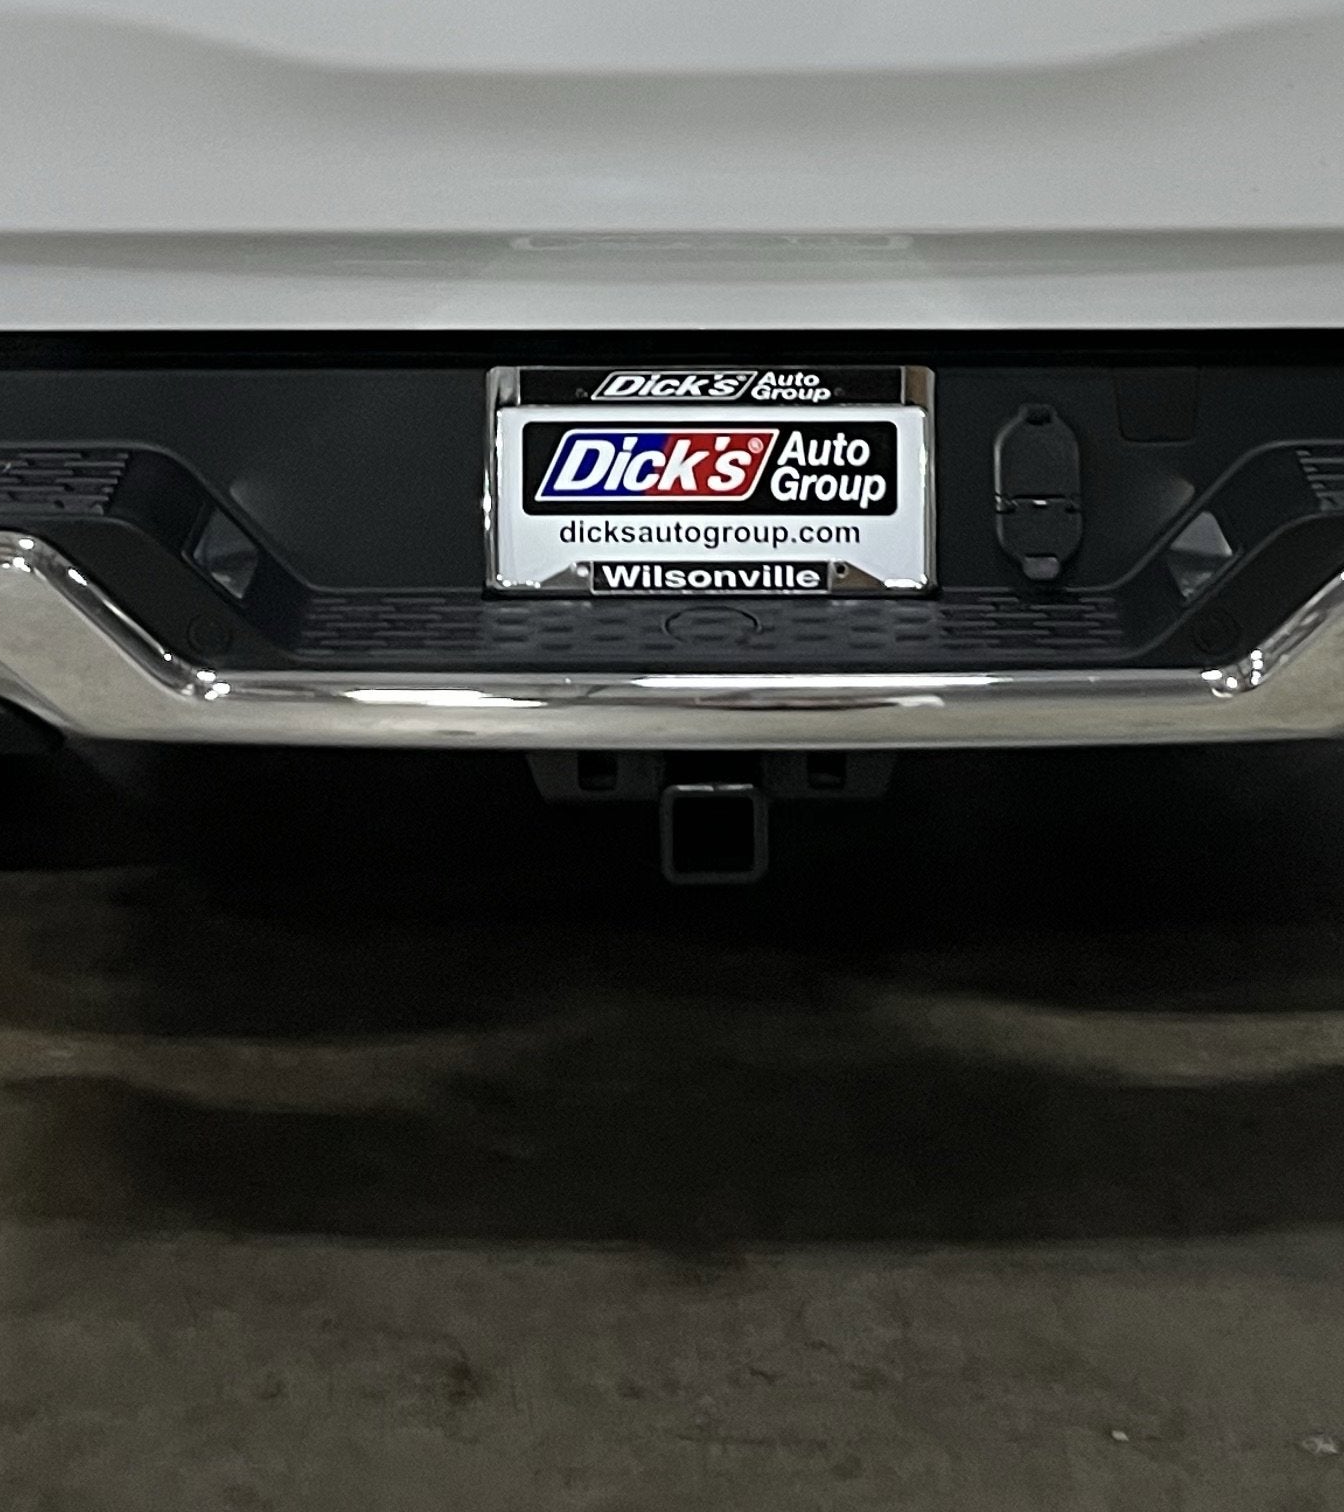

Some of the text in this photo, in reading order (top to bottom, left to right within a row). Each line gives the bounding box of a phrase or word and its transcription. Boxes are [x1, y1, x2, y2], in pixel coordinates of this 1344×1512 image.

[604, 372, 820, 397] Dick's Auto
[751, 386, 832, 402] Group
[553, 431, 871, 493] Dick's Auto
[769, 465, 888, 509] Group
[559, 520, 862, 549] dicksautogroup.com
[601, 564, 821, 590] Wilsonville
